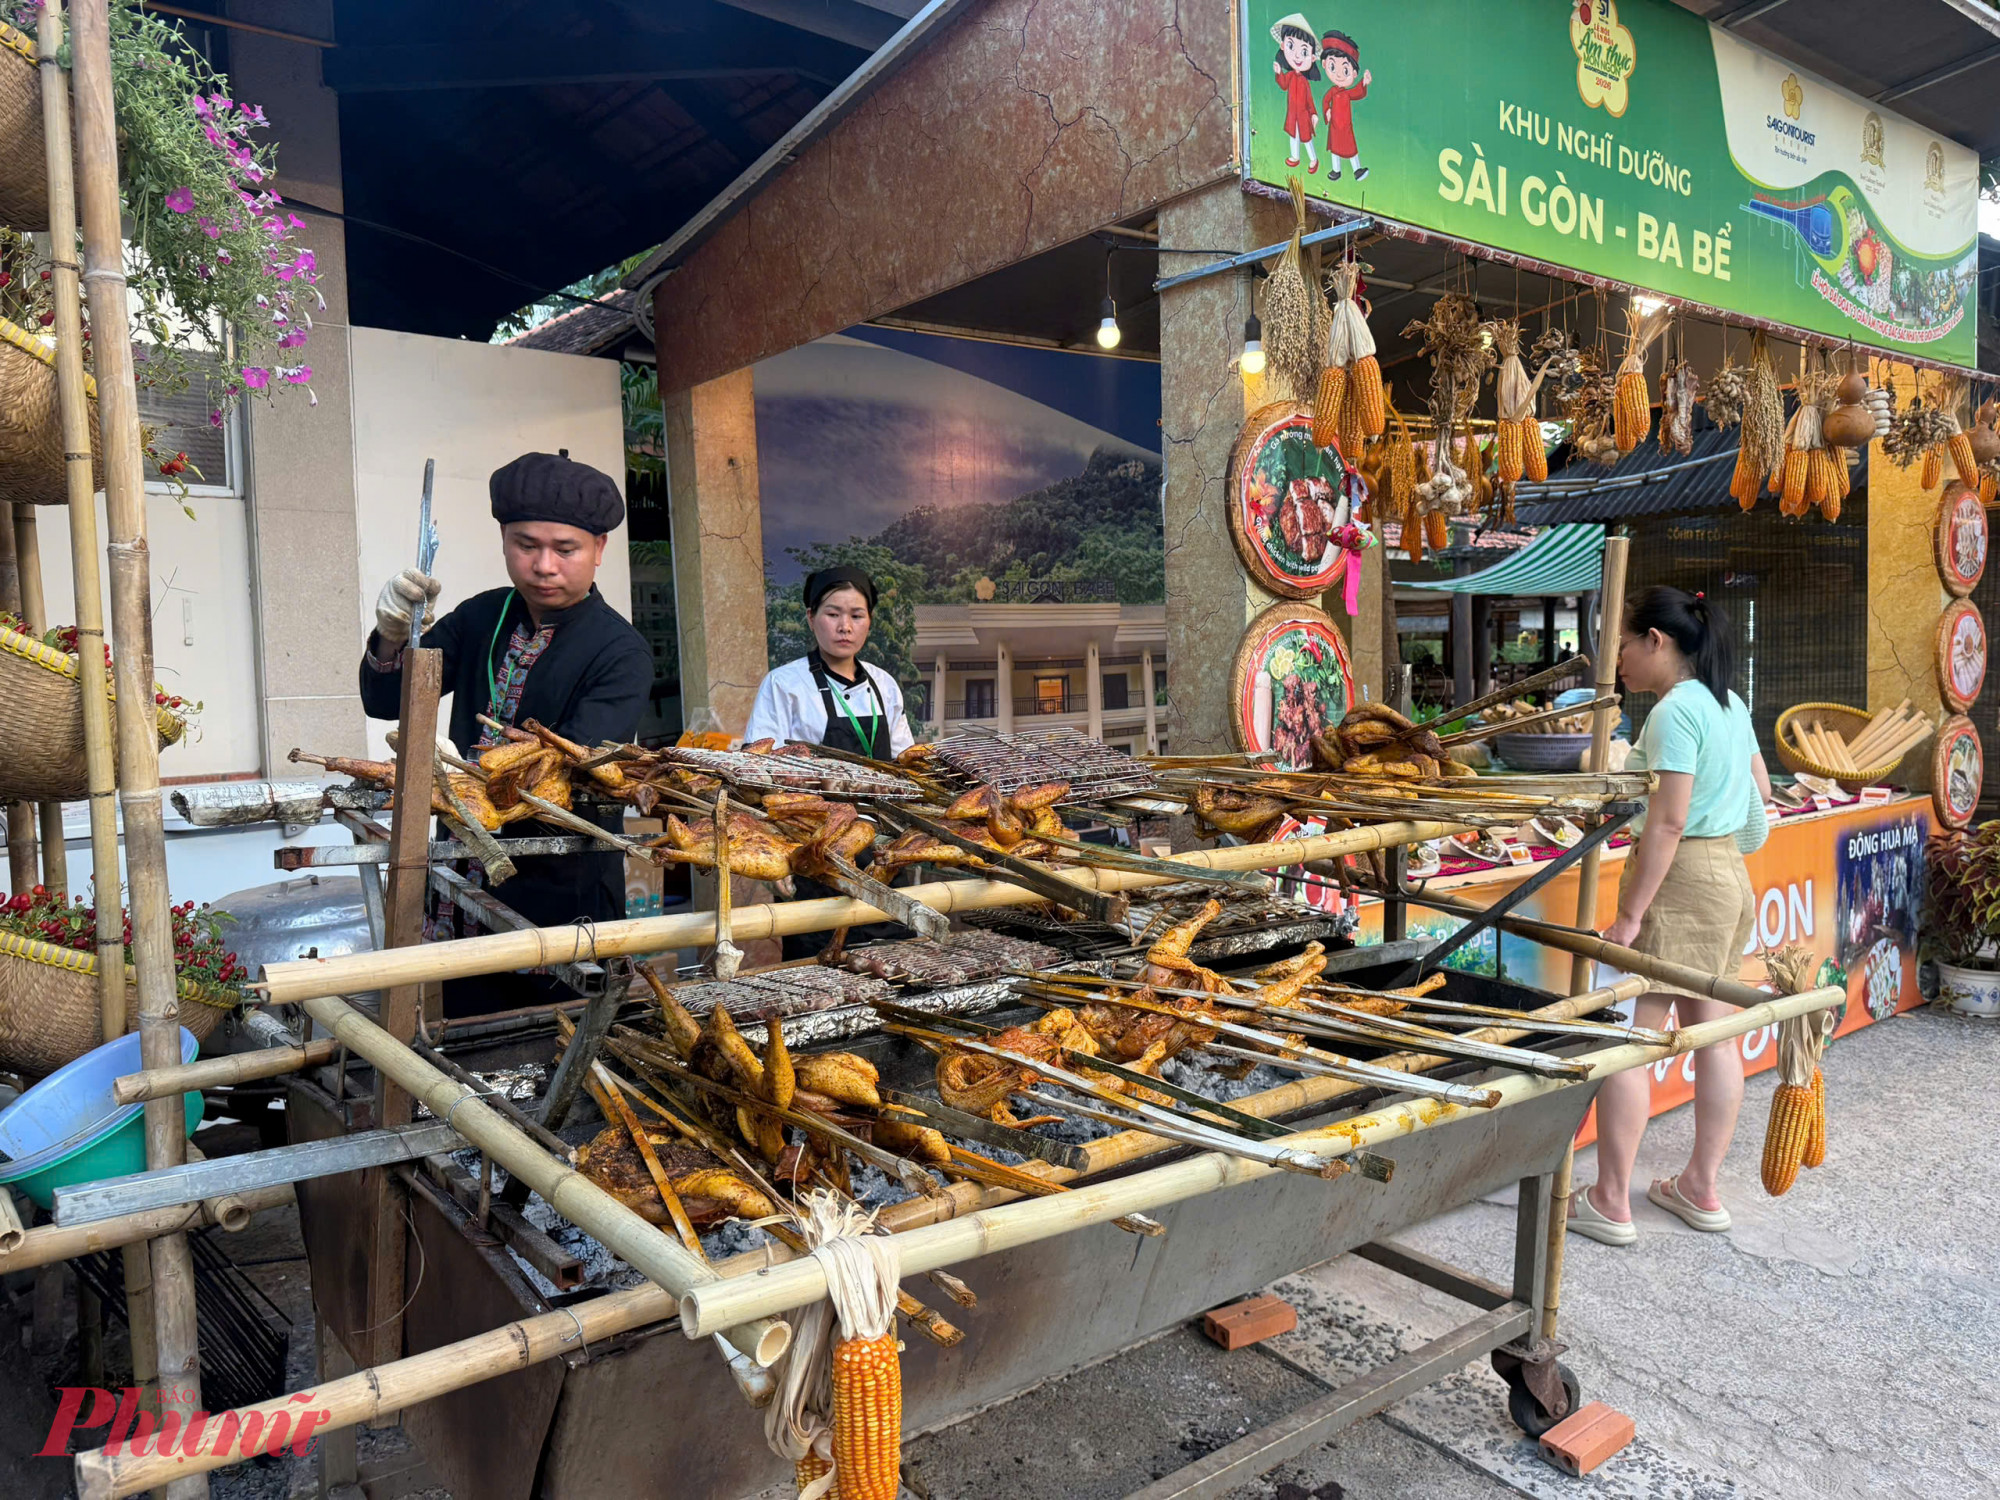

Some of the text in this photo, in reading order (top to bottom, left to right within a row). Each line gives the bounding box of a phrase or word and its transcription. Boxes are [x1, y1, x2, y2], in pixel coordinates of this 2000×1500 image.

[1767, 115, 1816, 147] SAIGONTOURIST
[1500, 100, 1691, 196] KHU NGHĨ DƯỠNG
[1438, 142, 1732, 281] SÀI GÒN - BA BỂ
[1270, 437, 1281, 450] Gà
[1266, 542, 1286, 563] chicken
[1286, 561, 1299, 571] with
[1299, 564, 1311, 573] wild
[1003, 581, 1116, 596] SAIGON BABE
[1848, 831, 1879, 861] ĐỘNG
[1903, 825, 1918, 848] MẠ
